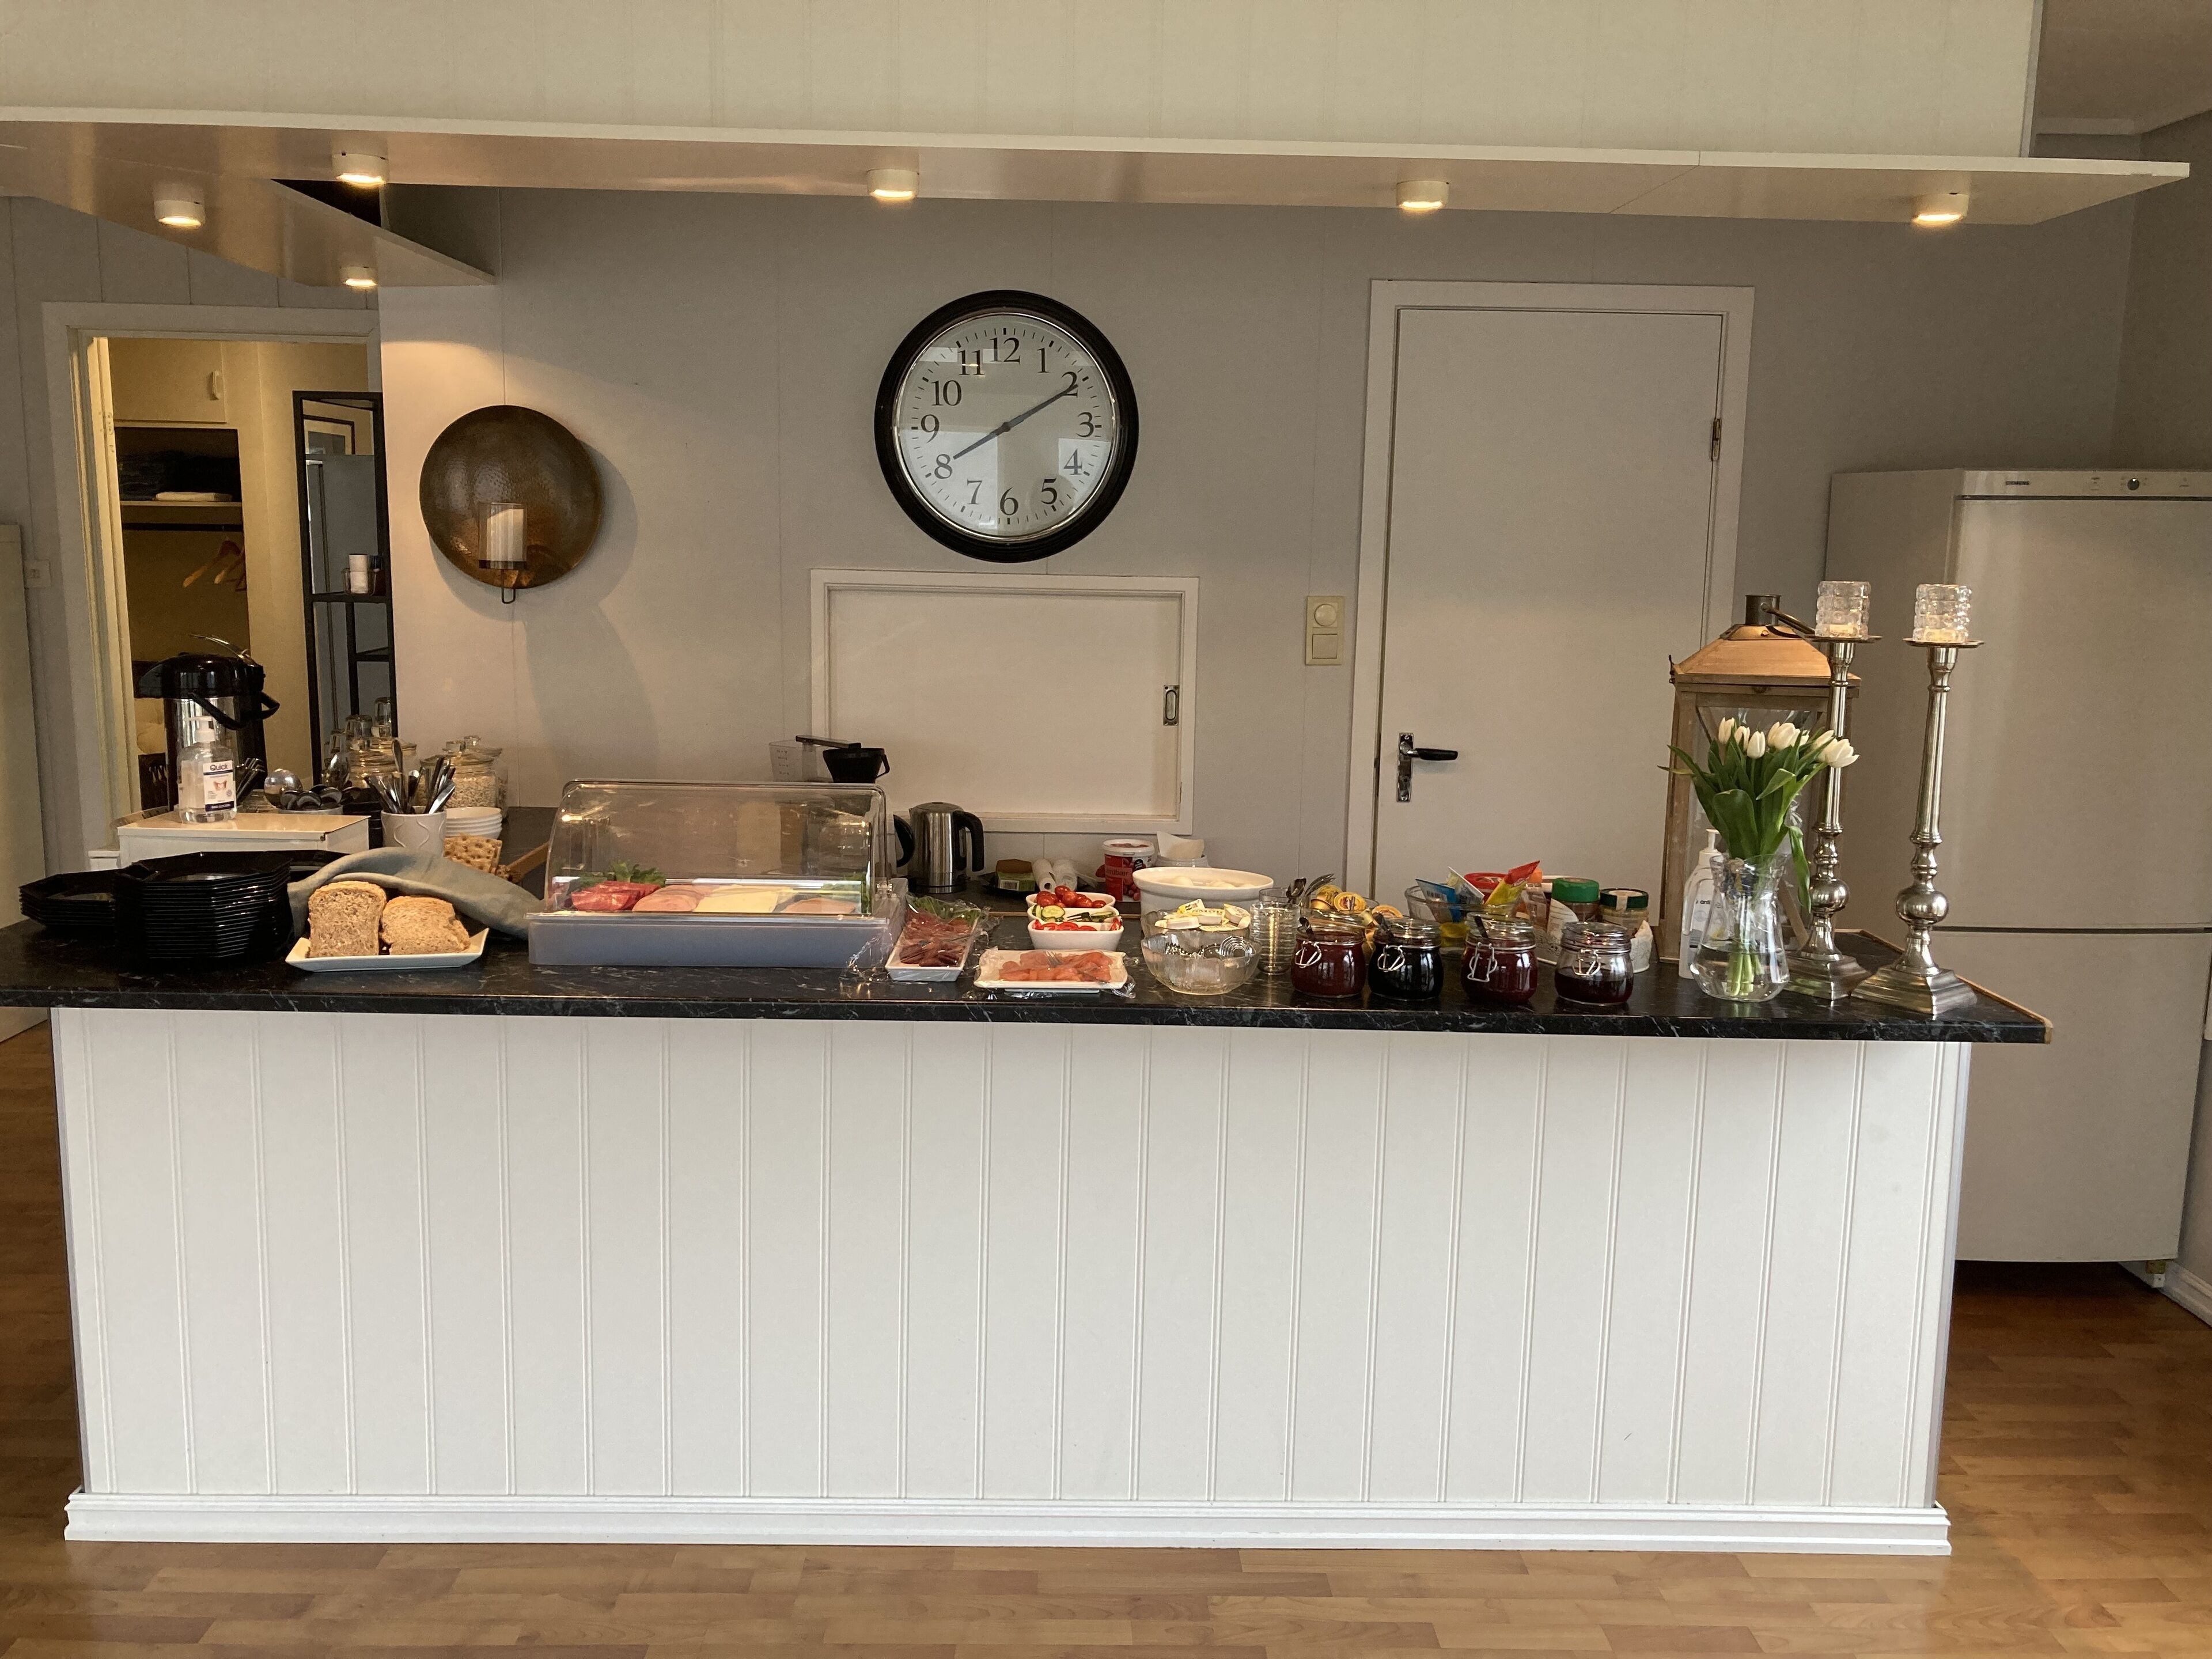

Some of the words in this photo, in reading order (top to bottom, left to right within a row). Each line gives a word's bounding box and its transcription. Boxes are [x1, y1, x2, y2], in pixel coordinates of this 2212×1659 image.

[959, 350, 984, 376] 11
[990, 338, 1020, 363] 12
[1037, 348, 1049, 373] 1
[931, 380, 961, 406] 10
[1062, 372, 1078, 396] 2
[921, 414, 940, 443] 9
[1077, 412, 1094, 437] 3
[934, 454, 953, 479] 8
[1064, 448, 1082, 475] 4
[967, 480, 983, 505] 7
[1000, 487, 1018, 516] 6
[1040, 478, 1057, 505] 5
